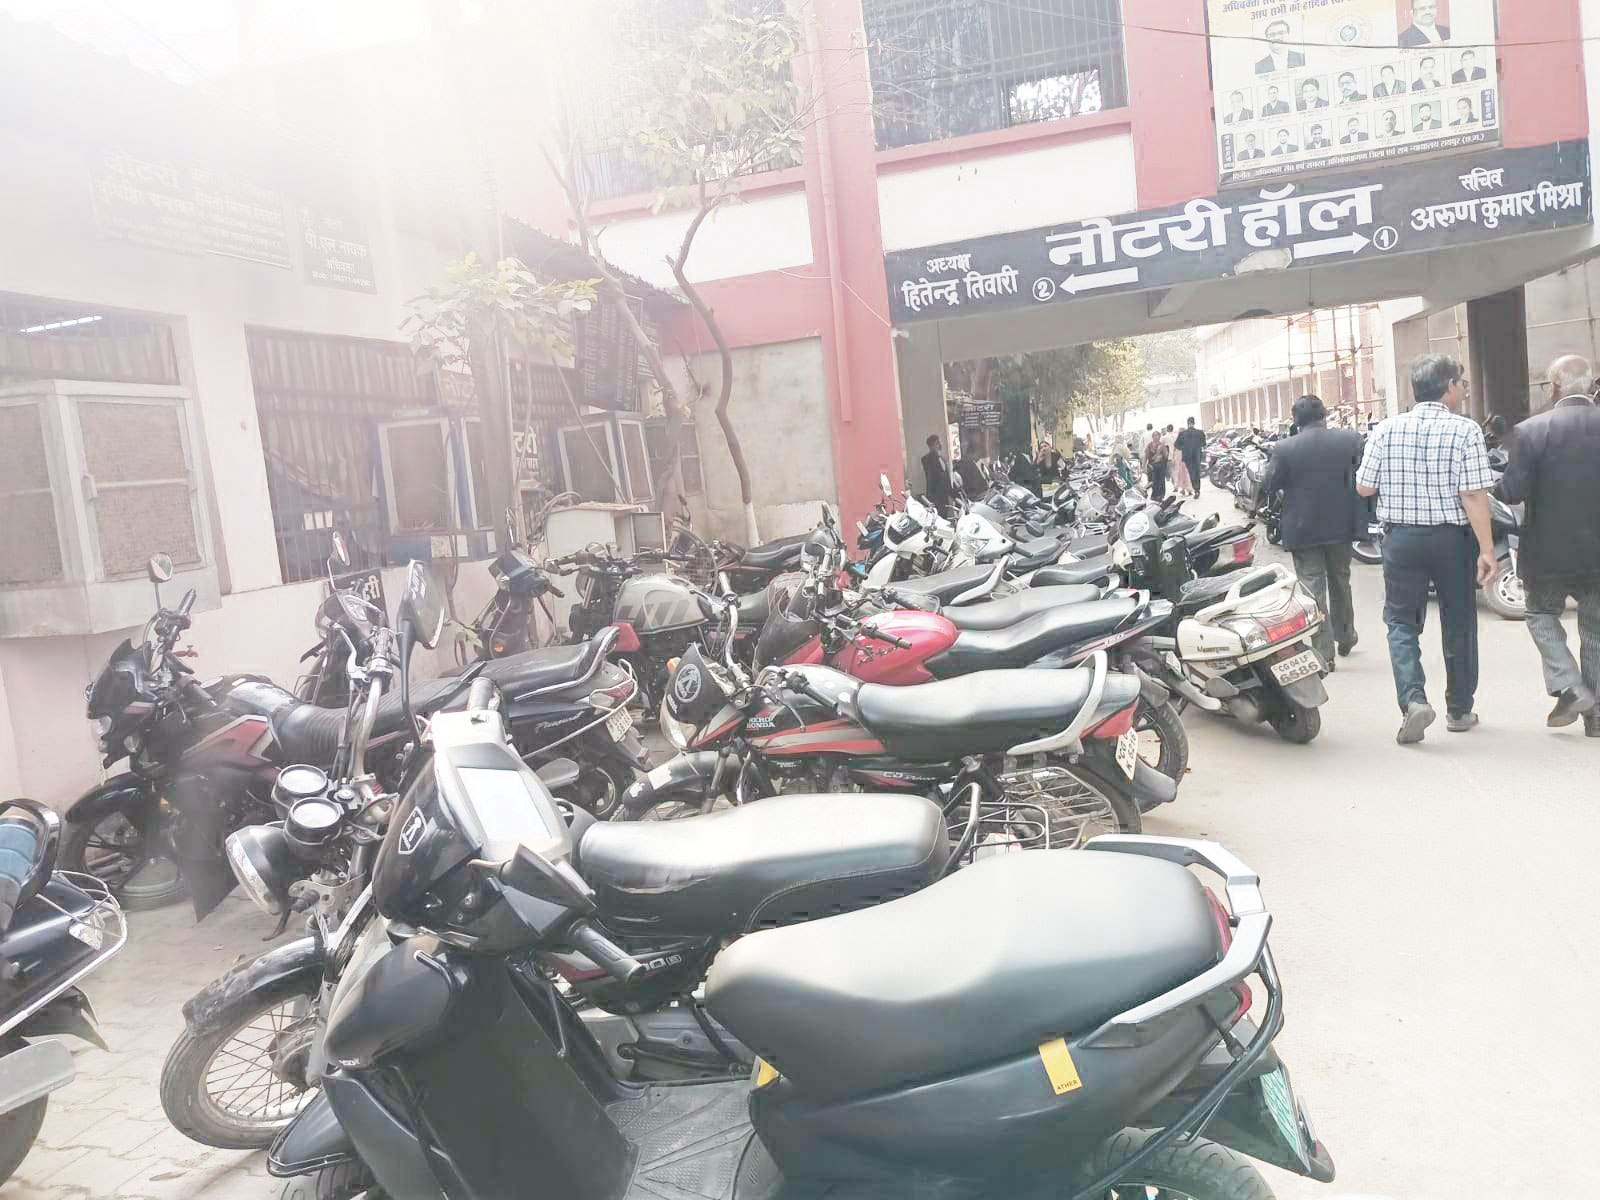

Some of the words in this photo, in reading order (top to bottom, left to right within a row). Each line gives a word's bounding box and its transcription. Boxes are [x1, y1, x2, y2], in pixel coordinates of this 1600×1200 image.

[1458, 167, 1505, 193] सचिव
[1481, 189, 1535, 229] कुमार
[1538, 180, 1583, 212] मिश्रा
[1046, 198, 1232, 267] नोटरी
[1240, 182, 1384, 247] हॉल
[926, 252, 972, 275] अध्यक्ष
[901, 276, 960, 312] हितेन्द्र
[964, 265, 1019, 301] तिवारी
[1278, 663, 1290, 673] CG
[1279, 661, 1319, 684] 6586
[1057, 1079, 1078, 1090] ATHER
